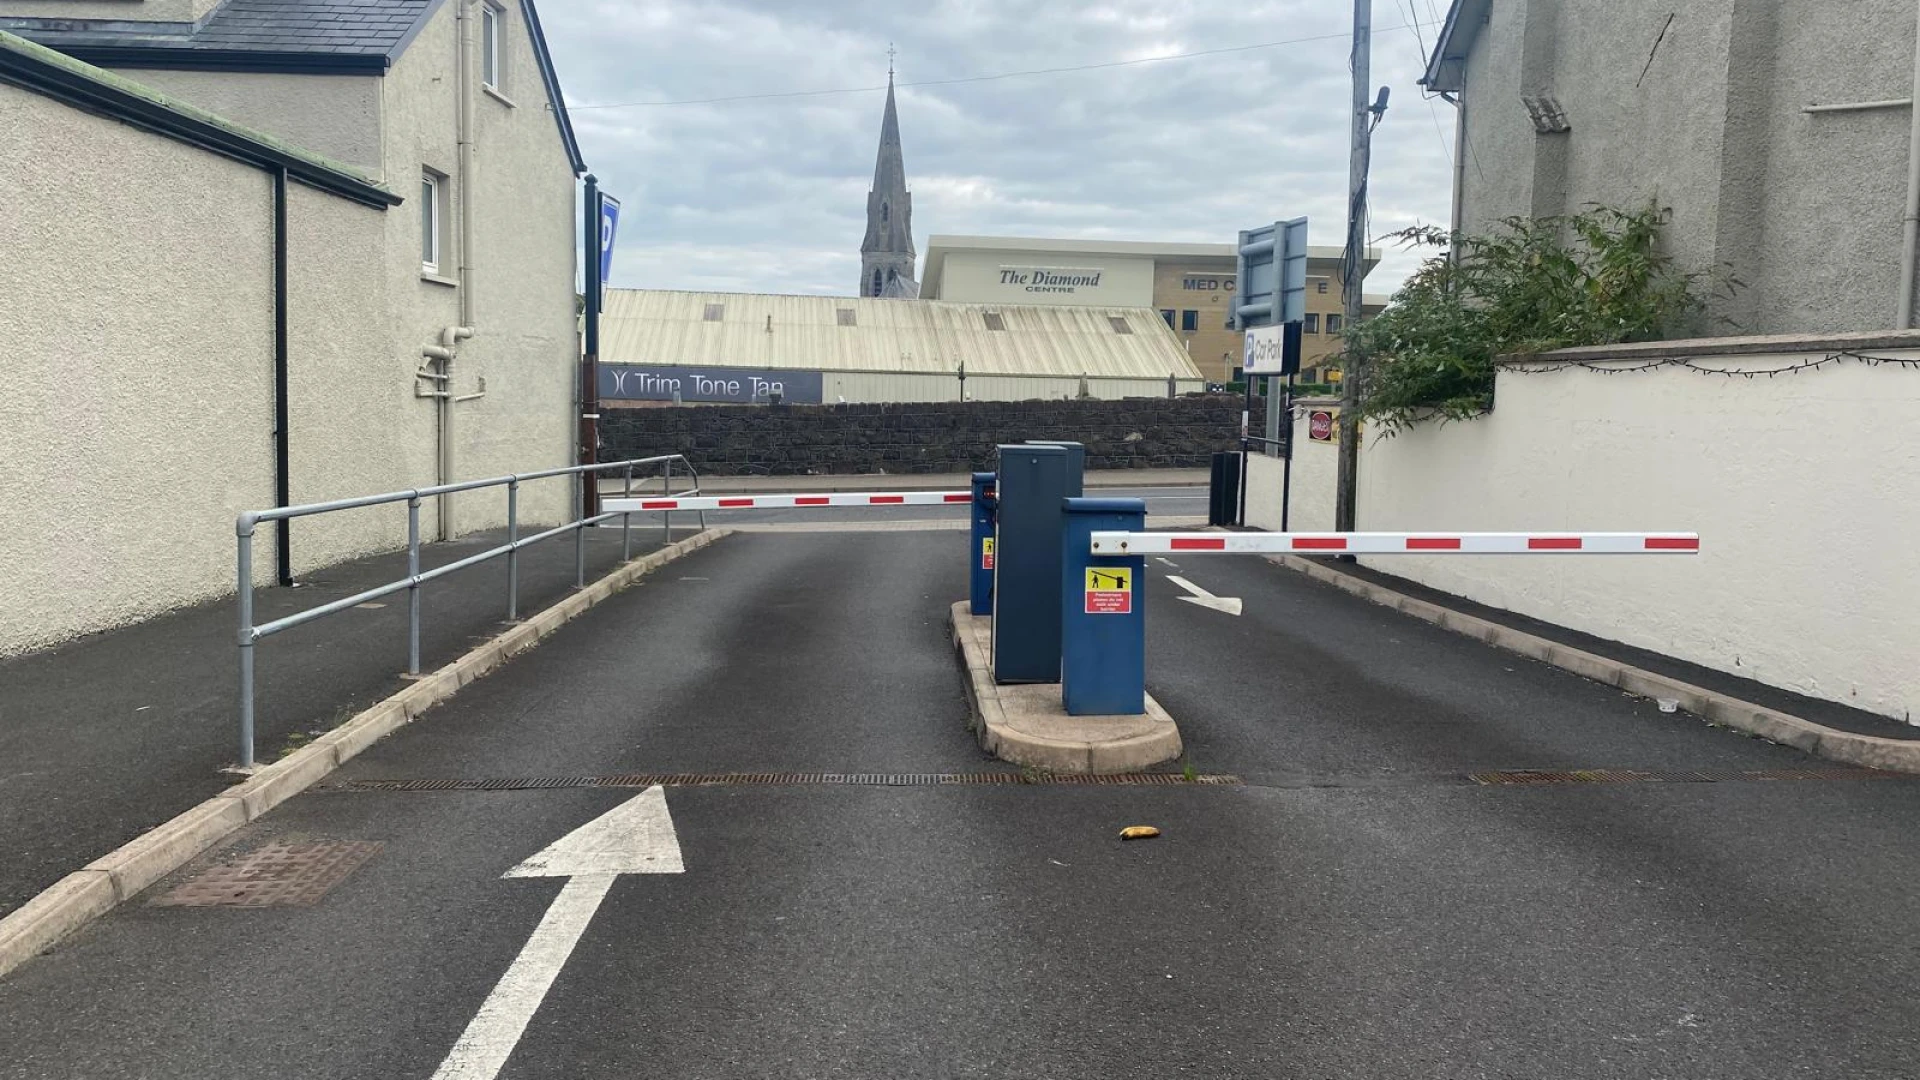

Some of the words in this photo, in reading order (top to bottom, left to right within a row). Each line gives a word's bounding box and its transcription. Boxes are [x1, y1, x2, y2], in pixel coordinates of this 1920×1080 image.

[1000, 269, 1028, 285] The
[1032, 270, 1101, 287] Diamond
[1182, 278, 1219, 292] MED
[1025, 286, 1076, 294] CENTRE
[1246, 336, 1253, 366] P
[1255, 339, 1267, 360] Car
[1267, 337, 1281, 361] Park
[634, 372, 681, 394] Trim
[690, 374, 740, 397] Tone
[748, 376, 784, 398] Tan
